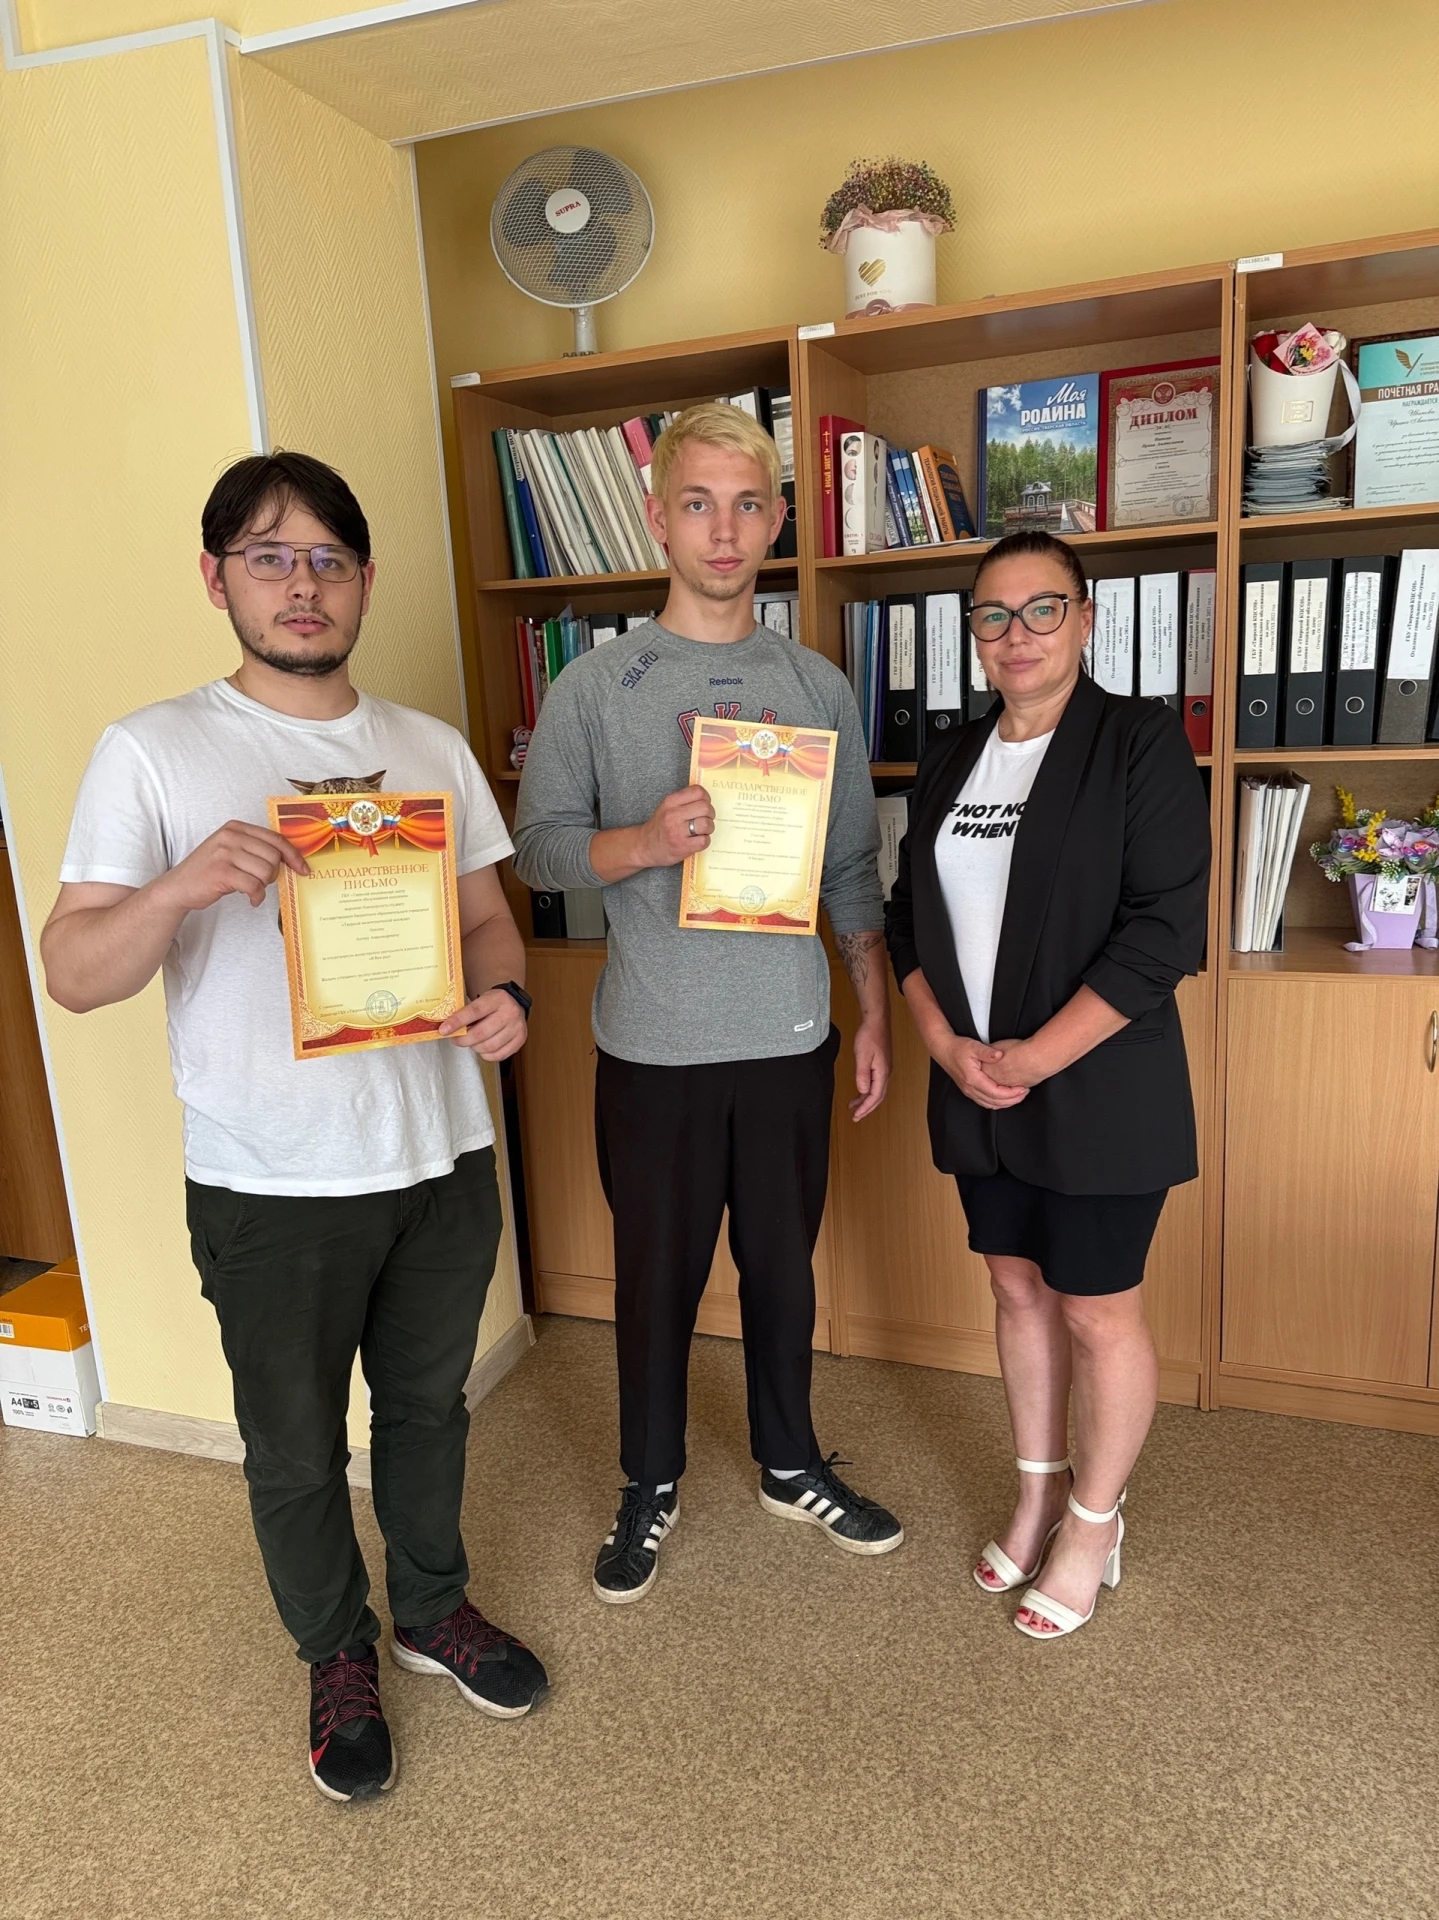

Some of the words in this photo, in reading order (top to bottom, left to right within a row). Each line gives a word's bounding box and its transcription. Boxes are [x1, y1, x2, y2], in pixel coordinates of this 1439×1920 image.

[555, 201, 581, 217] SUPRA
[1046, 382, 1087, 406] Моя
[1378, 384, 1421, 399] ПОЧЁТНАЯ
[1402, 398, 1438, 407] НАГРАЖДАЕТСЯ
[1021, 402, 1086, 426] РОДИНА
[1129, 408, 1198, 430] ДИПЛОМ
[924, 458, 936, 486] ТЕХНОЛОГИЯ
[932, 486, 945, 516] СОЦИАЛЬНОЙ
[940, 517, 949, 535] РАБОТЫ
[621, 650, 659, 689] SKA.RU
[709, 677, 743, 686] Reebok
[712, 780, 808, 796] БЛАГОДАРСТВЕННОЕ
[738, 792, 781, 803] ПИСЬМО
[956, 804, 1002, 818] NOT
[952, 821, 1016, 838] WHEN
[308, 864, 429, 879] БЛАГОДАРСТВЕННОЕ
[344, 878, 397, 890] ПИСЬМО
[12, 1398, 22, 1406] A4
